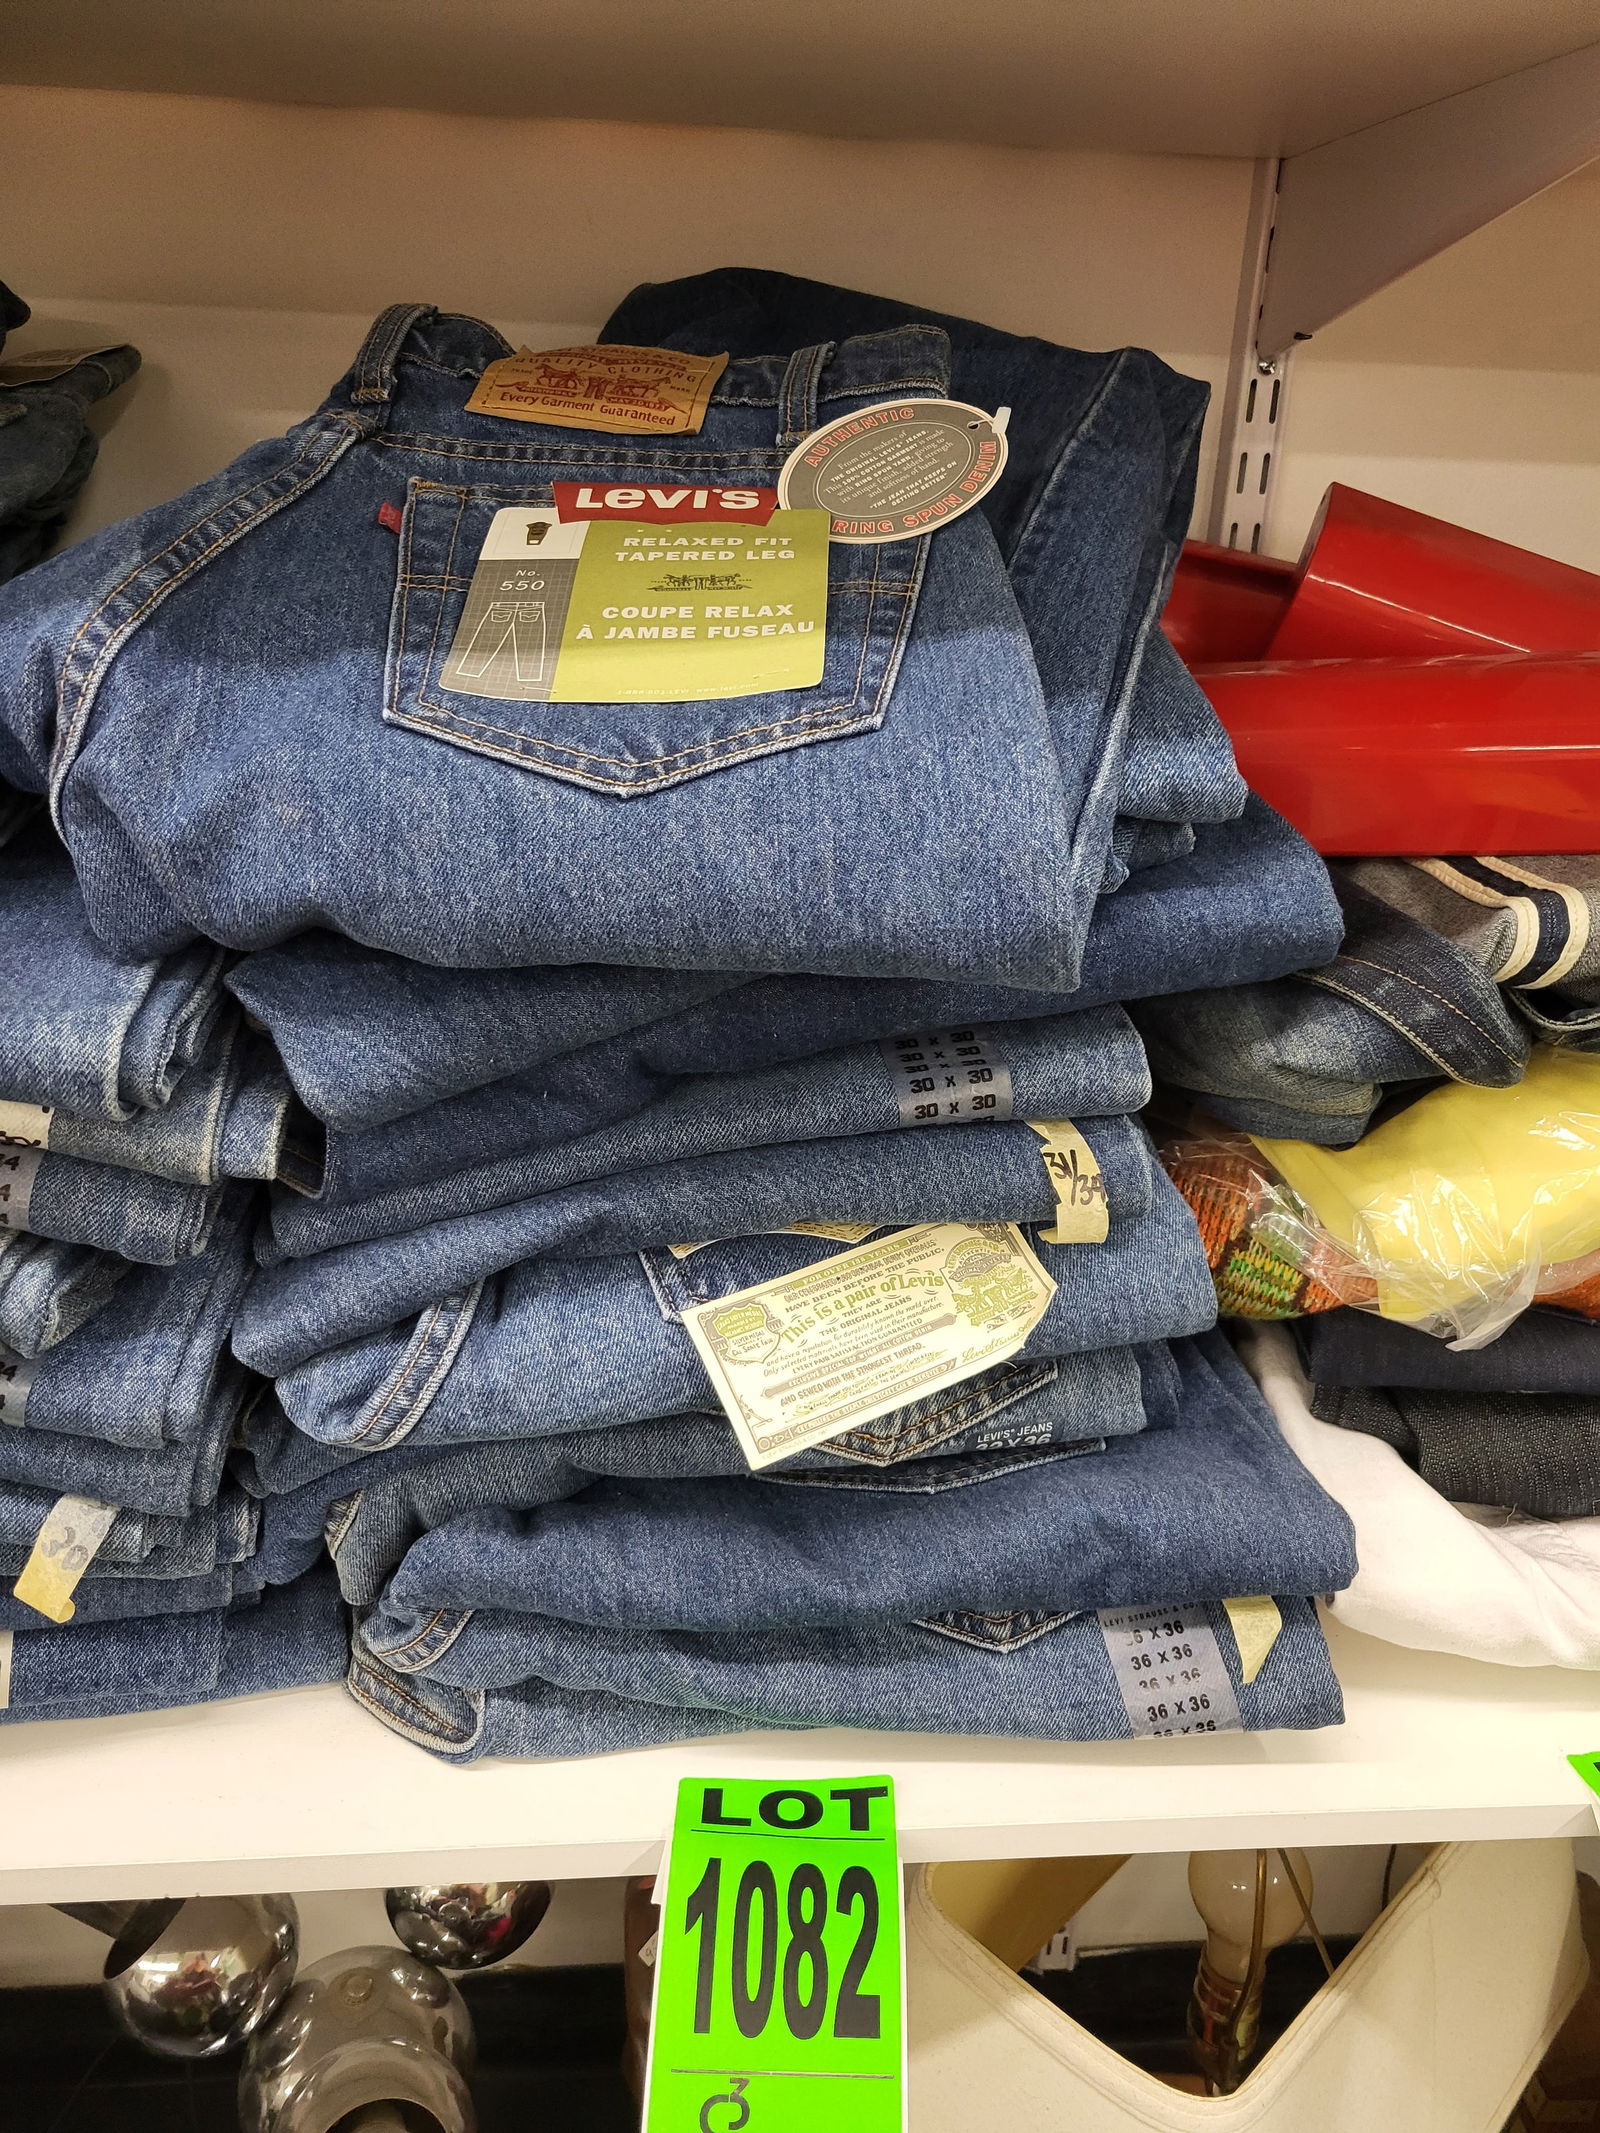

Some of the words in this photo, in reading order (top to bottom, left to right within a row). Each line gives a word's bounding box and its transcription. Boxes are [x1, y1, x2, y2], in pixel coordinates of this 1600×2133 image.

[515, 357, 599, 369] QUALITY
[607, 365, 698, 383] CLOTHING
[500, 391, 539, 406] Every
[541, 395, 595, 412] Garment
[600, 405, 676, 426] Guaranteed
[804, 407, 915, 468] AUTHENTIC
[837, 455, 859, 470] From
[858, 447, 872, 459] the
[872, 435, 898, 452] makers
[897, 429, 907, 439] of
[824, 481, 842, 495] This
[860, 459, 886, 476] COTTON
[886, 442, 917, 462] GARMENT
[924, 426, 945, 441] made
[830, 472, 845, 483] THE
[845, 454, 878, 475] ORIGINAL
[835, 483, 854, 497] with
[854, 475, 872, 488] RING
[872, 464, 892, 478] SPUN
[913, 440, 937, 458] giving
[936, 436, 944, 444] to
[851, 481, 878, 499] unique
[900, 455, 924, 472] added
[923, 439, 954, 460] strength
[832, 519, 894, 534] RING
[902, 493, 963, 528] SPUN
[960, 441, 997, 493] DENIM
[866, 486, 882, 498] and
[882, 471, 910, 490] softness
[909, 466, 919, 476] of
[887, 488, 905, 501] JEAN
[905, 478, 922, 491] THAT
[923, 466, 946, 481] KEEPS
[946, 460, 957, 469] ON
[890, 487, 919, 507] GETTING
[623, 537, 743, 547] RELAXED
[754, 537, 793, 546] FIT
[615, 550, 735, 562] TAPERED
[746, 549, 795, 560] LEG
[499, 580, 546, 591] 550
[515, 569, 541, 577] No.
[602, 606, 694, 619] COUPE
[704, 603, 794, 618] RELAX
[576, 624, 598, 640] À
[604, 626, 697, 640] JAMBE
[707, 621, 815, 639] FUSEAU
[895, 1038, 919, 1050] 30
[950, 1030, 975, 1042] 30
[899, 1052, 924, 1062] 30
[955, 1046, 981, 1056] 30
[904, 1064, 929, 1073] 30
[909, 1077, 935, 1093] 30
[967, 1068, 993, 1084] 30
[915, 1103, 939, 1119] 30
[972, 1094, 996, 1110] 30
[785, 1299, 810, 1313] HAVE
[812, 1287, 841, 1303] BEEN
[843, 1270, 883, 1291] BEFORE
[884, 1261, 905, 1274] THE
[906, 1245, 944, 1265] PUBLIC.
[781, 1316, 815, 1342] This
[813, 1305, 832, 1319] is
[832, 1297, 845, 1311] a
[844, 1284, 875, 1308] pair
[879, 1277, 896, 1292] of
[819, 1325, 838, 1337] THE
[839, 1307, 882, 1329] ORIGINAL
[882, 1294, 912, 1310] JEANS
[841, 1305, 863, 1318] THEY
[864, 1297, 882, 1308] ARE
[873, 1312, 895, 1325] known
[894, 1308, 904, 1316] the
[904, 1301, 922, 1312] world
[792, 1361, 813, 1373] EVERY
[813, 1354, 830, 1365] PAIR
[829, 1335, 877, 1358] SATISFACTION
[877, 1317, 923, 1339] GUARANTEED
[762, 1365, 779, 1378] Only
[779, 1393, 797, 1407] AND
[797, 1382, 824, 1399] SEWED
[821, 1375, 841, 1389] WITH
[840, 1369, 855, 1382] THE
[855, 1354, 893, 1376] STRONGEST
[1017, 1421, 1053, 1436] JEANS
[1103, 1618, 1124, 1627] LEVI
[1128, 1607, 1169, 1622] STRAUSS
[1163, 1620, 1184, 1637] 36
[1131, 1653, 1152, 1671] 36
[1172, 1643, 1193, 1661] 36
[1180, 1667, 1201, 1685] 36
[1147, 1703, 1168, 1722] 36
[1189, 1693, 1210, 1712] 36
[701, 1786, 888, 1831] LOT
[684, 1857, 881, 2039] 1082
